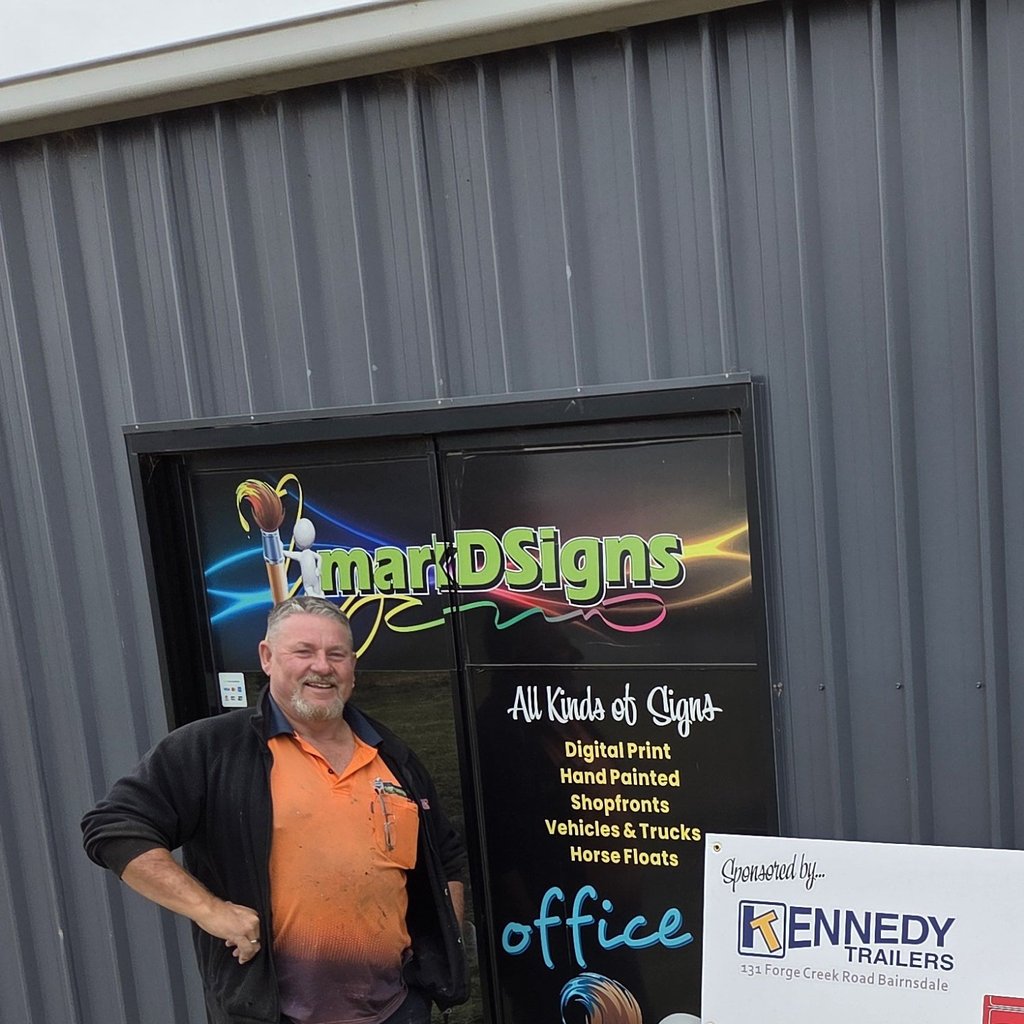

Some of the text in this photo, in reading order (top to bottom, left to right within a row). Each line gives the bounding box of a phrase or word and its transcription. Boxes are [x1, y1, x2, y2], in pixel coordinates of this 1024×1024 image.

[507, 682, 723, 738] All Kinds of Signs
[565, 740, 671, 763] Digital Print
[560, 768, 680, 787] Hand Painted
[570, 794, 670, 816] Shopfronts
[545, 819, 701, 841] Vehicles & Trucks
[570, 846, 679, 867] Horse Floats
[721, 854, 796, 892] Sponsored
[502, 885, 694, 969] office
[844, 946, 955, 971] TRAILERS
[741, 964, 949, 992] 131 Forge Creek Road Bairnsdale
